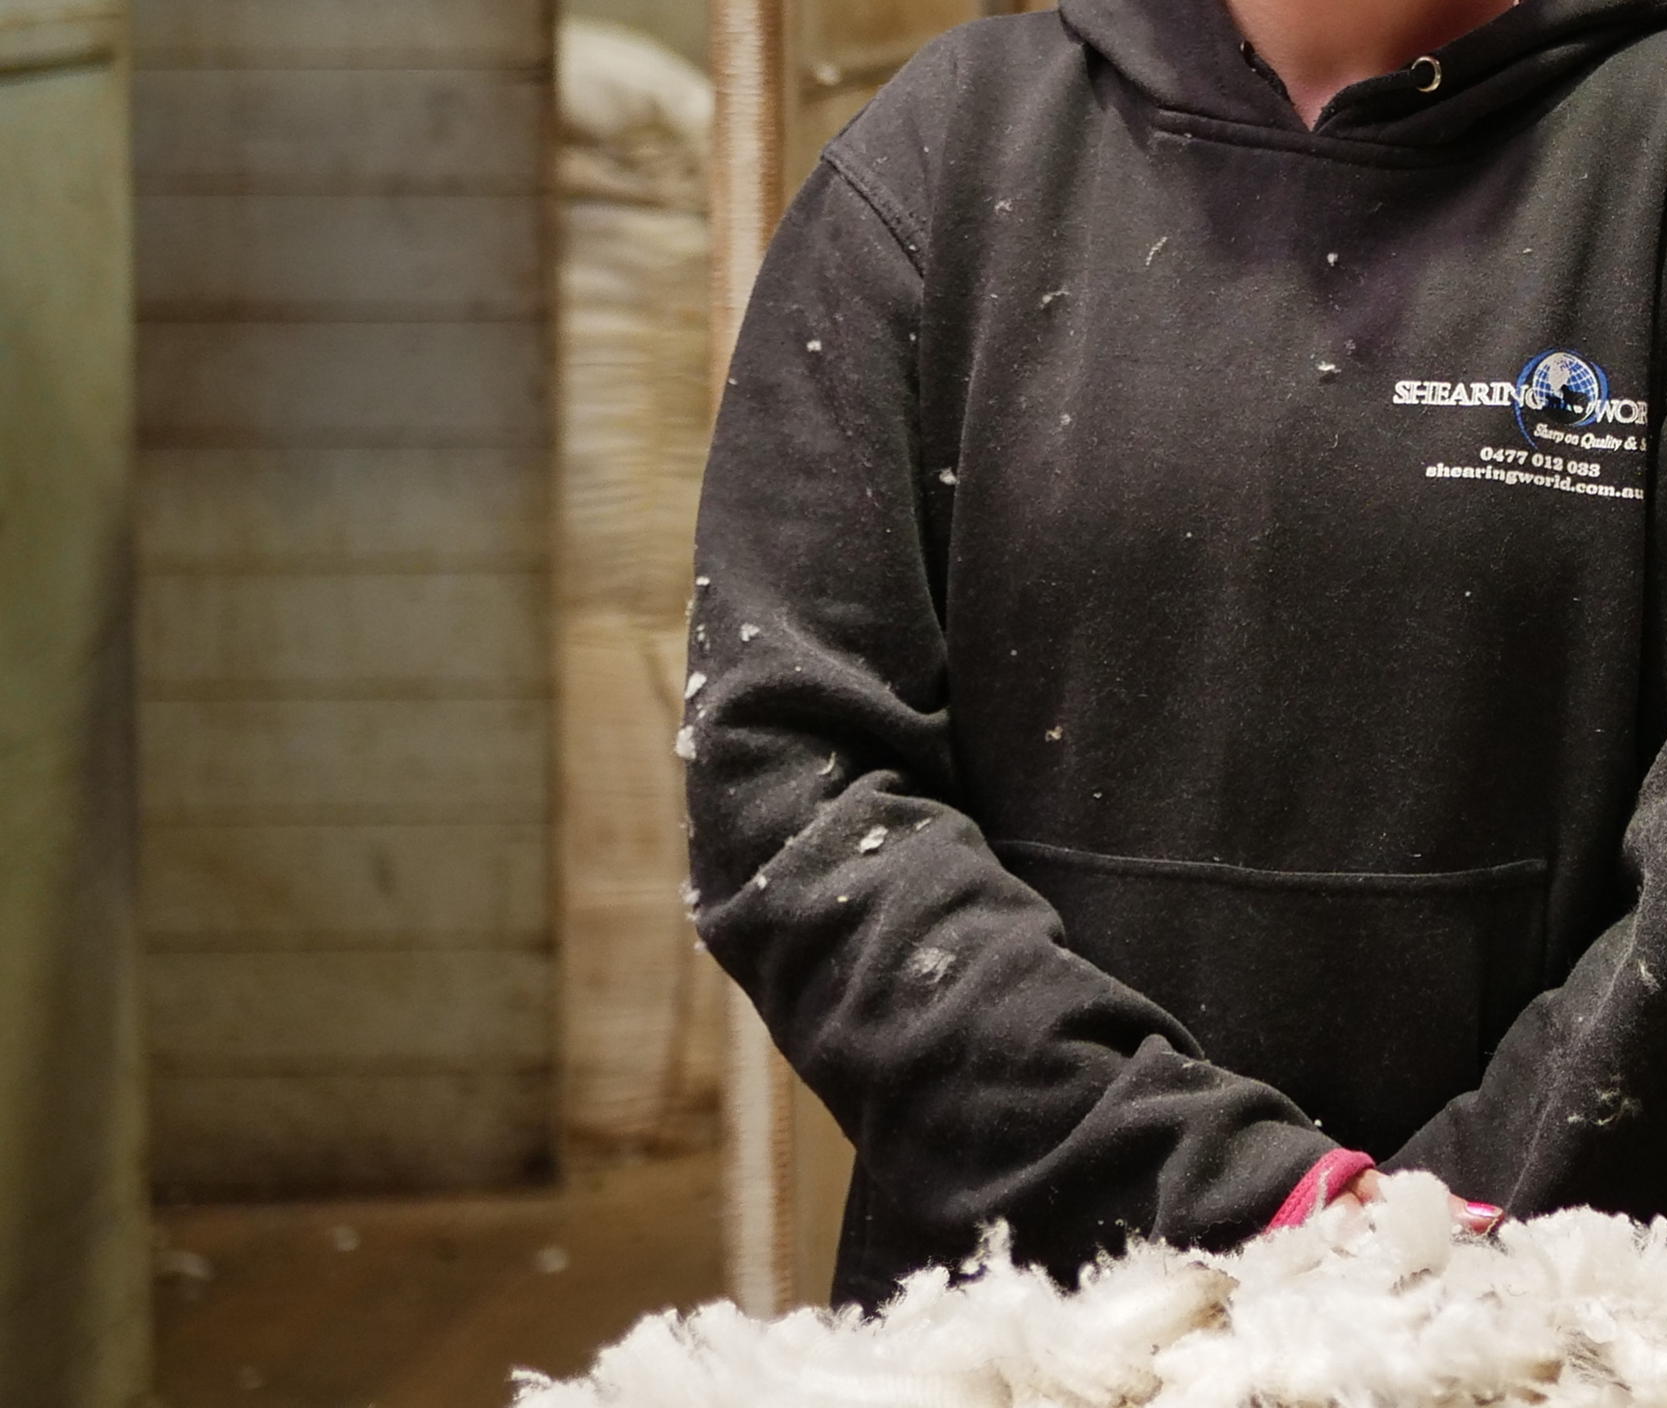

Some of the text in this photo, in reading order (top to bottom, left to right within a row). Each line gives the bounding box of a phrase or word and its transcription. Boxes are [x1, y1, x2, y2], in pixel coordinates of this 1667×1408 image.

[1393, 380, 1547, 410] SHEARING
[1581, 432, 1622, 452] Quality
[1480, 446, 1527, 467] 0477
[1531, 452, 1563, 472] 012
[1425, 462, 1644, 500] shearingworld.com.au
